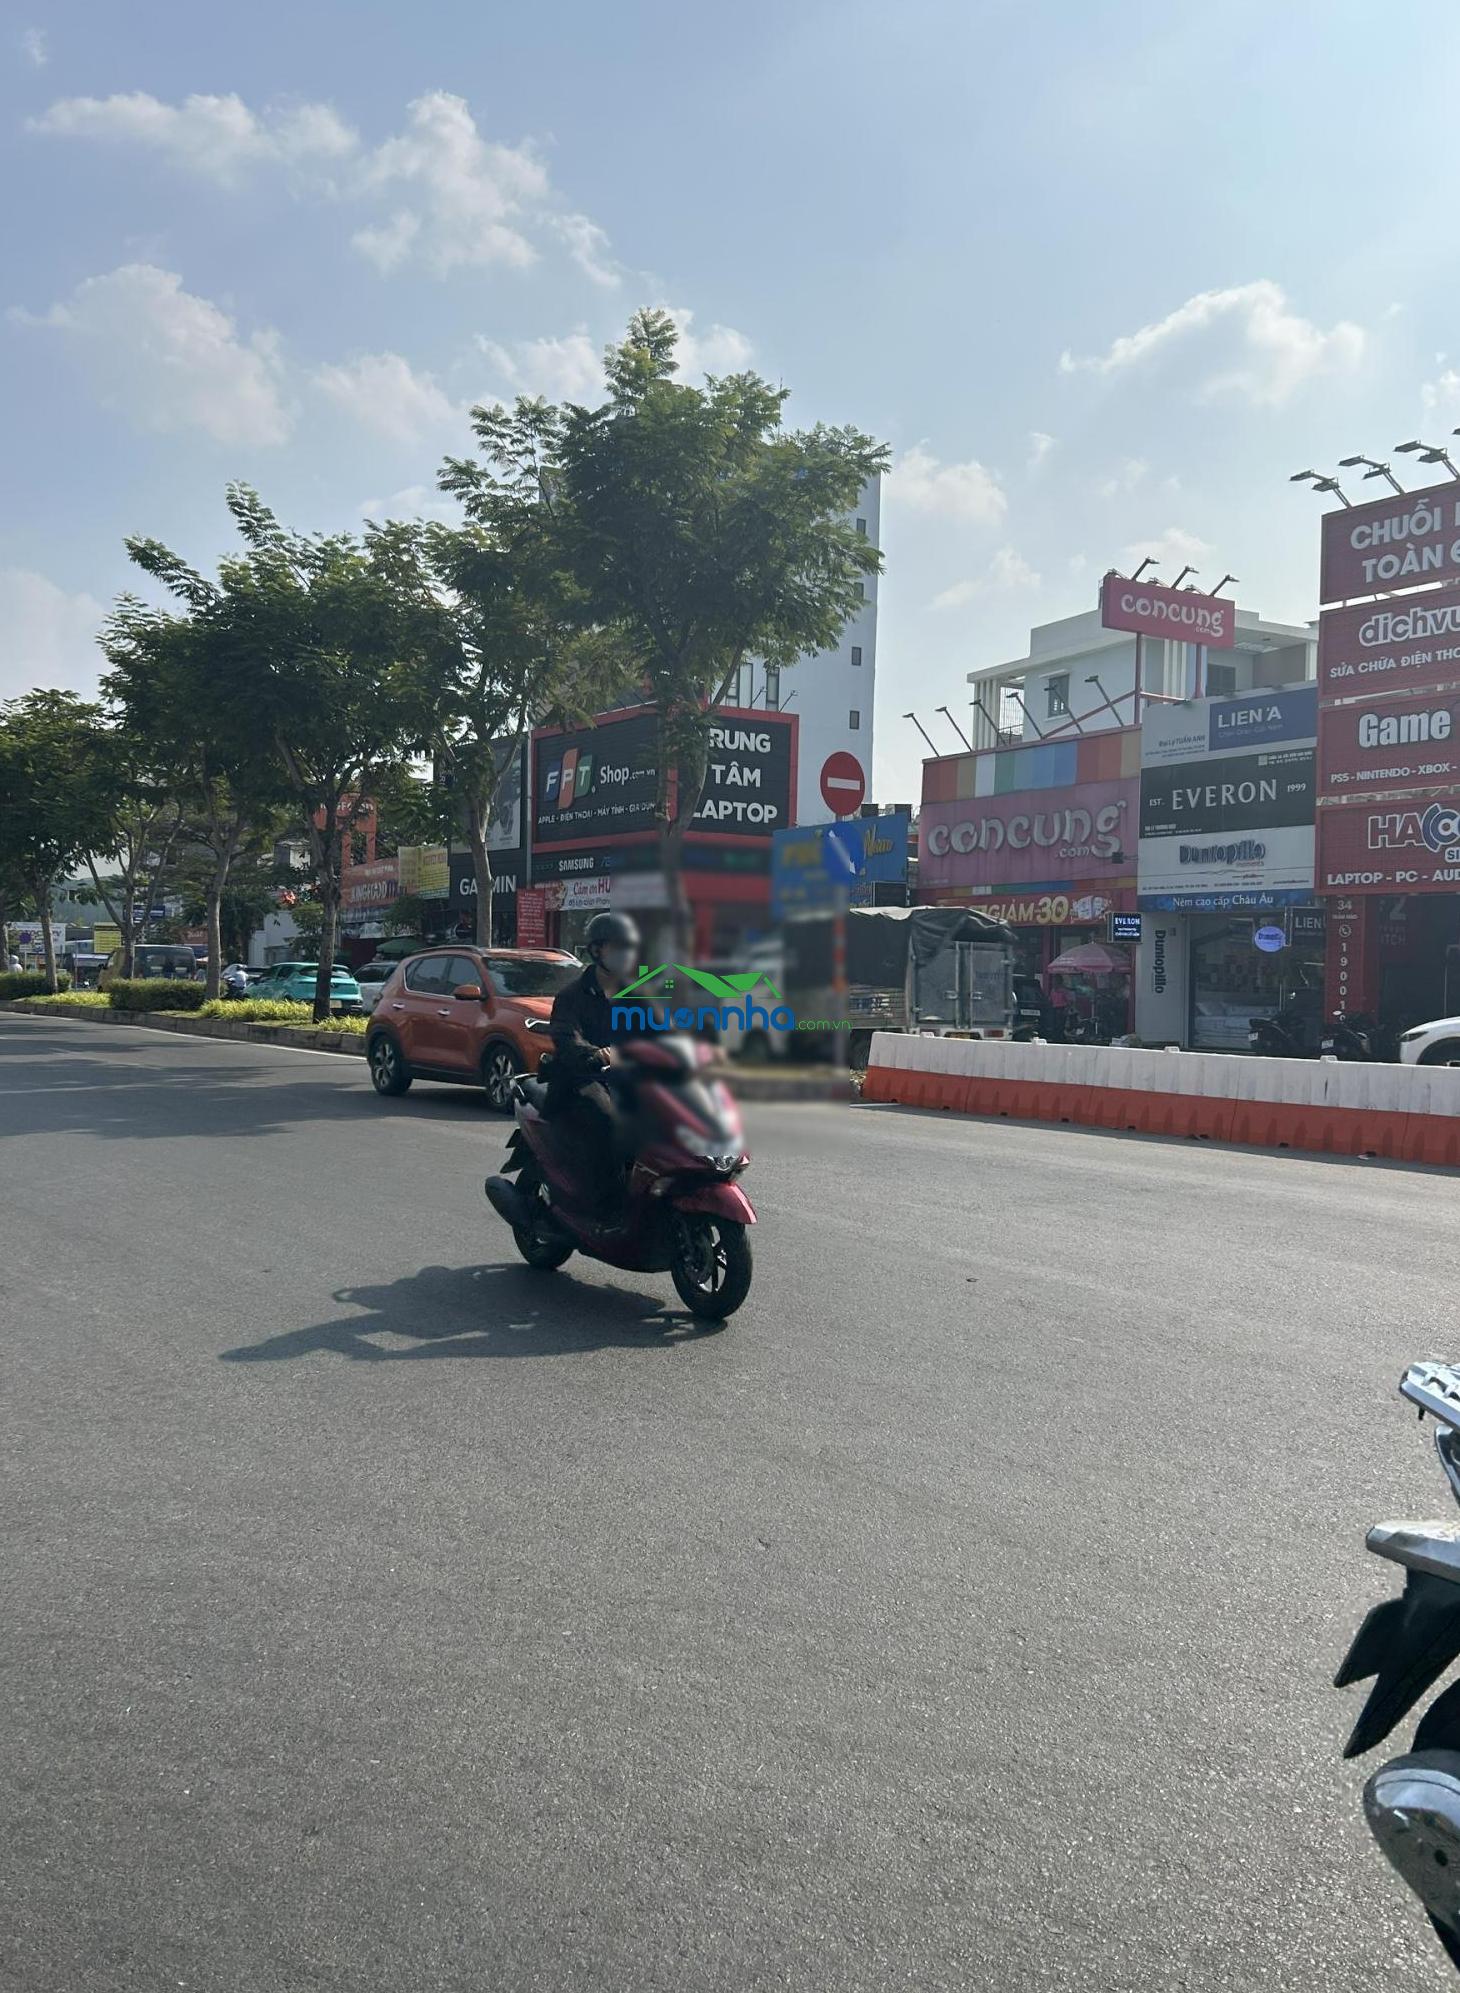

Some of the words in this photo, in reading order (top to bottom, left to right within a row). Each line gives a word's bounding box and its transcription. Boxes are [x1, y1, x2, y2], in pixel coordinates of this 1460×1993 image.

[1350, 498, 1442, 550] CHUỖI
[1362, 542, 1444, 584] TOÀN
[1121, 594, 1224, 637] concung
[1330, 661, 1355, 678] SỬA
[1358, 656, 1396, 673] CHỮA
[1401, 650, 1432, 668] ĐIỆN
[709, 728, 771, 753] RUNG
[1359, 710, 1451, 747] Game
[545, 765, 592, 794] FPT
[711, 761, 761, 788] TÂM
[1331, 773, 1350, 783] PS5
[1356, 767, 1410, 780] NINTENDO
[1418, 762, 1450, 775] XBOX
[1172, 779, 1277, 810] EVERON
[1287, 783, 1307, 793] 1999
[538, 815, 555, 825] APPLE
[597, 805, 609, 816] MÁY
[693, 799, 778, 823] APTOP
[927, 800, 1127, 858] concung
[559, 857, 594, 872] SAMSUNG
[1327, 872, 1383, 885] LAPTOP
[1396, 870, 1418, 883] PC
[460, 875, 517, 896] GAMIN
